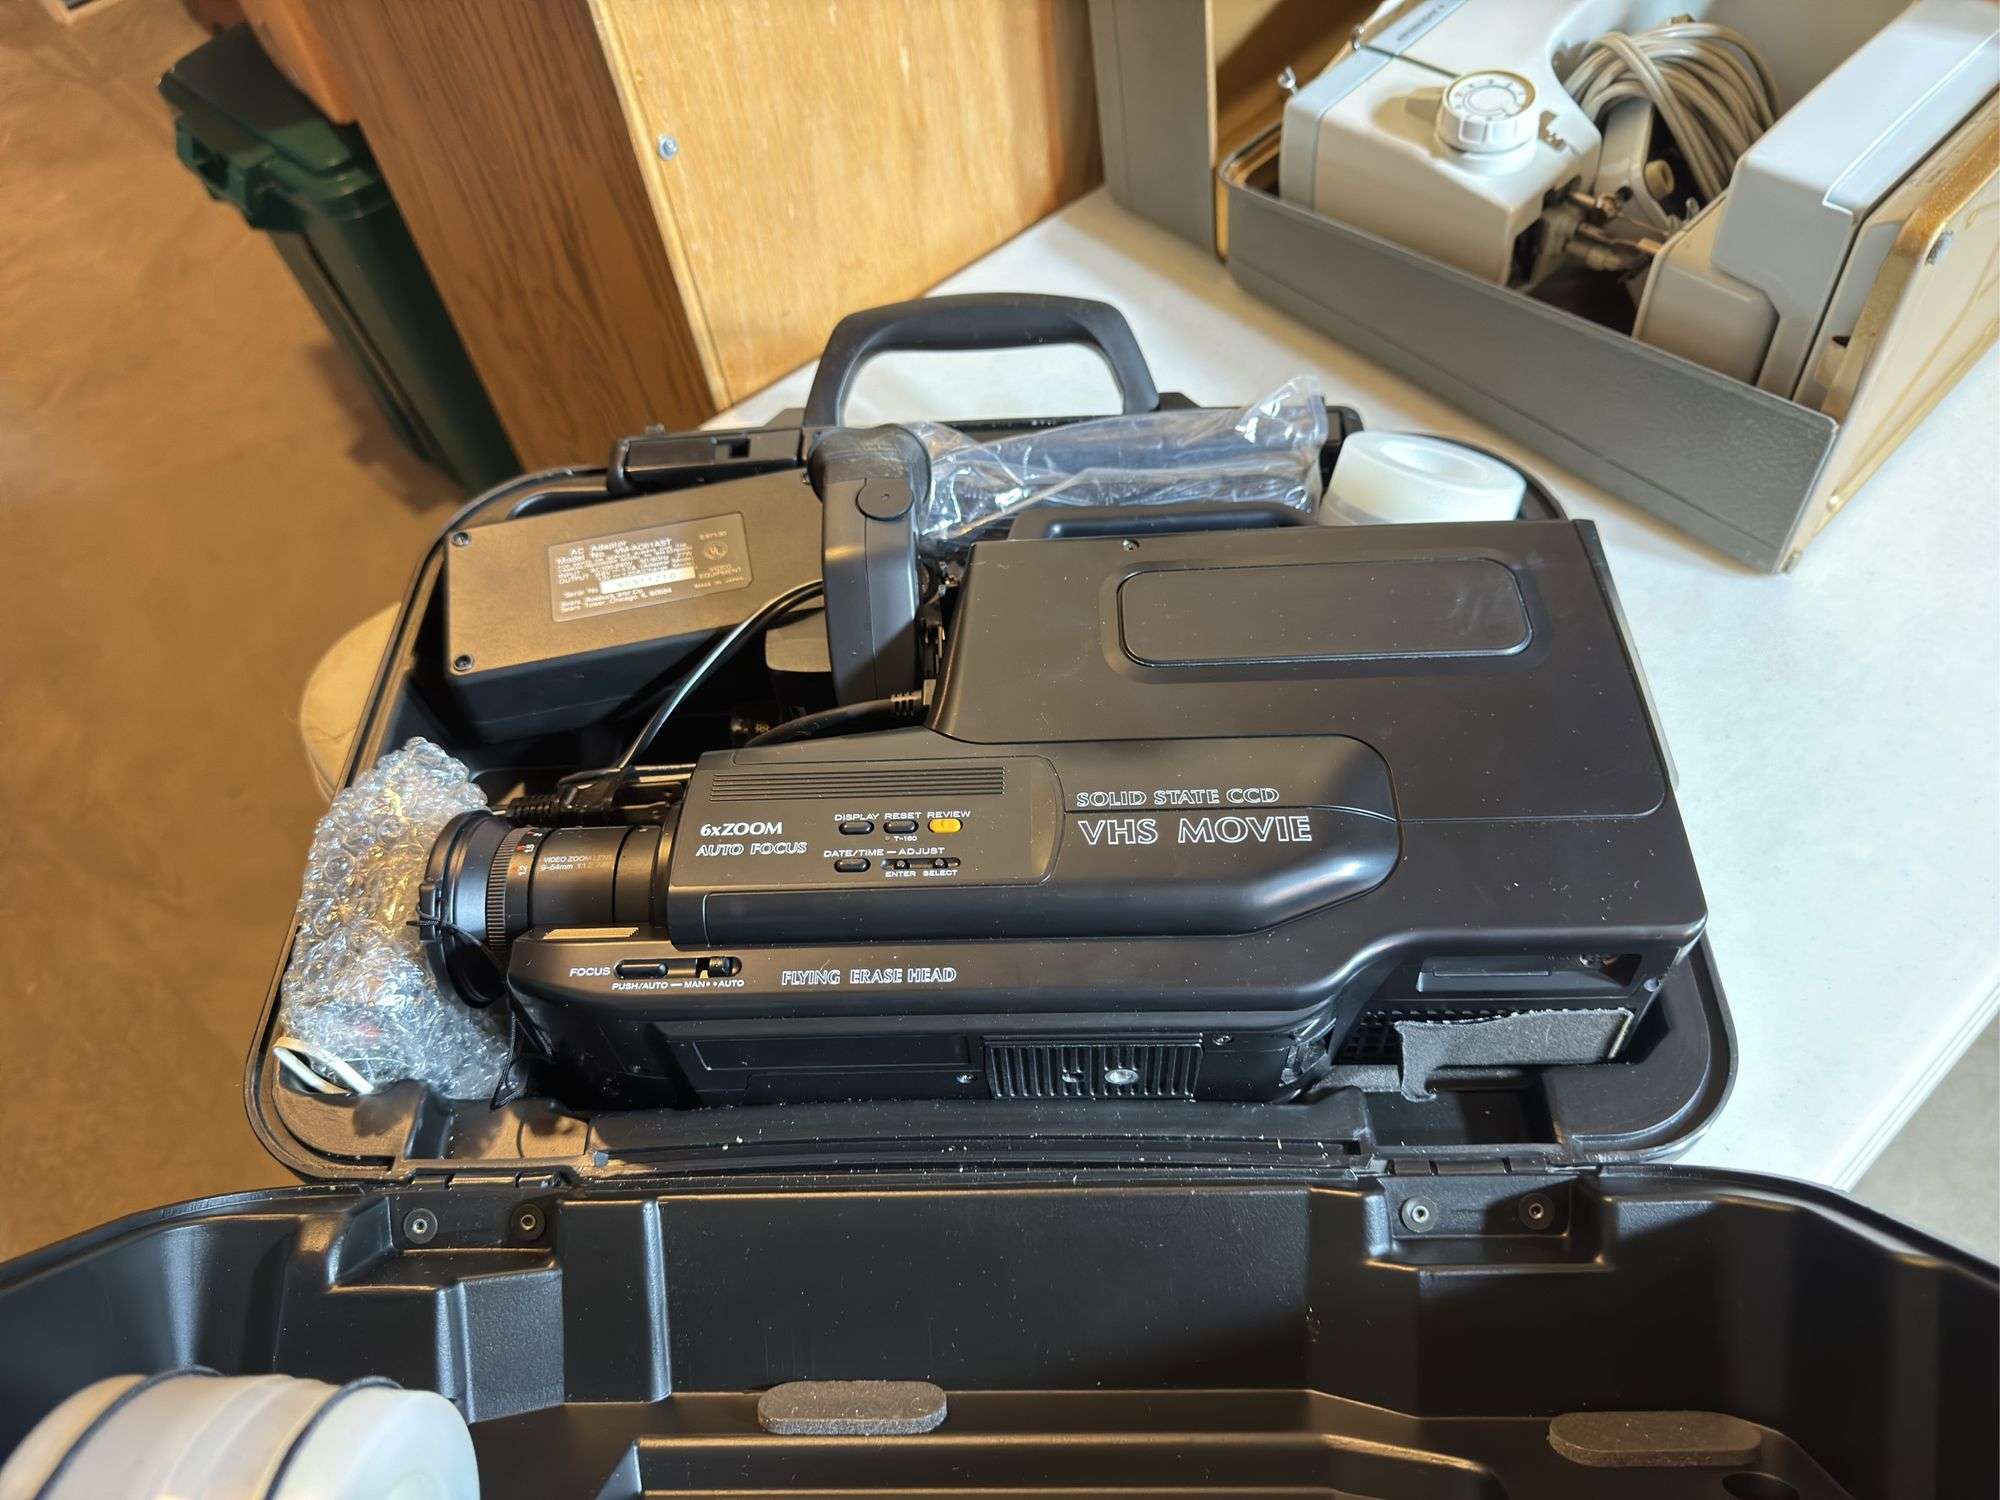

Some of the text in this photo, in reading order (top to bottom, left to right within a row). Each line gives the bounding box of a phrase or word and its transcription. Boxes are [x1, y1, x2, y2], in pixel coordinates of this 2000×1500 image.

[1076, 788, 1280, 807] SOLID STATE CCD
[834, 810, 971, 821] DISPLAY RESET REVIEW
[700, 822, 783, 836] 6xZOOM
[1078, 816, 1312, 845] VHS MOVIE
[696, 842, 808, 857] AUTO FOCUS
[823, 847, 945, 858] DATE/TIME ADJUST
[543, 855, 567, 863] VIDEO
[885, 869, 958, 878] ENTER SELECT
[569, 967, 611, 977] FOCUS
[781, 967, 957, 986] FLYING ERASE HEAD
[611, 979, 745, 991] PUSH/AUTO MAN AUTO
